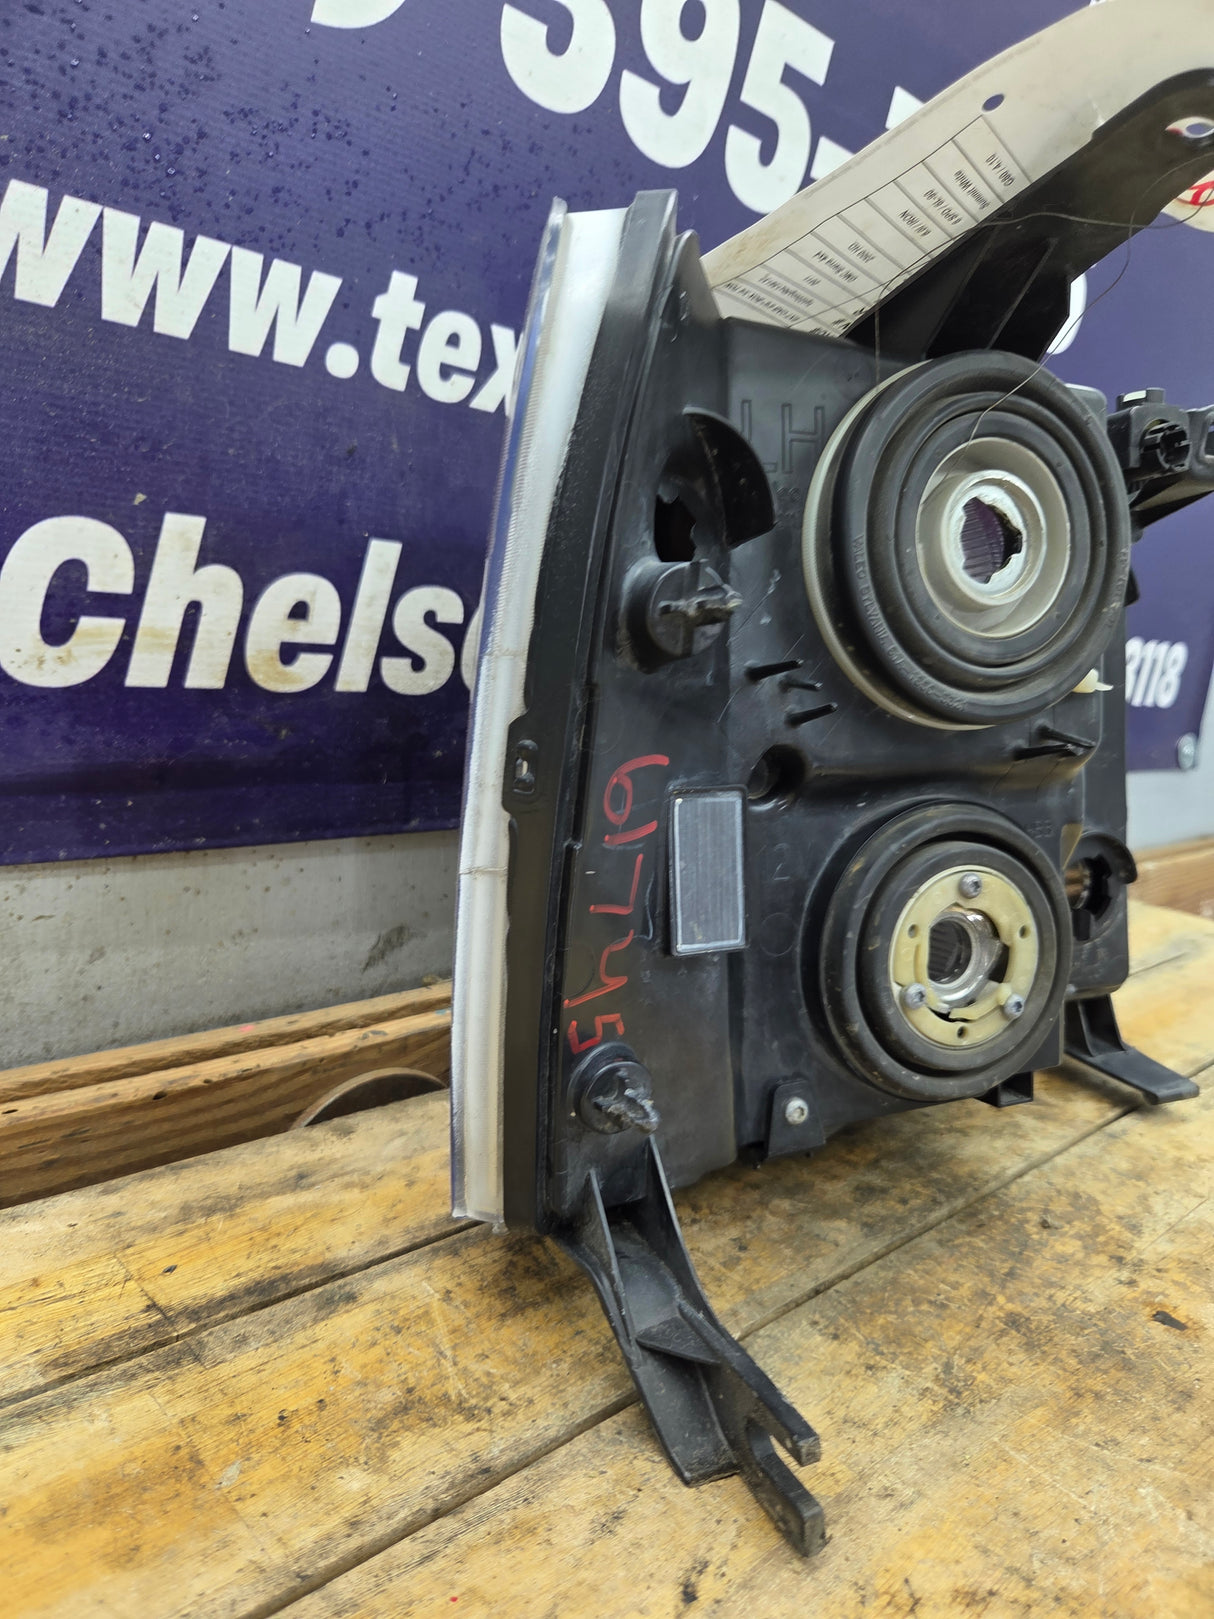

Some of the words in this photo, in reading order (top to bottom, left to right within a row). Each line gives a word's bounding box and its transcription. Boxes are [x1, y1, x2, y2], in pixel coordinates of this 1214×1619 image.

[953, 169, 973, 192] White
[967, 185, 990, 210] Summit
[0, 510, 482, 697] Chels
[563, 753, 670, 1055] 61745
